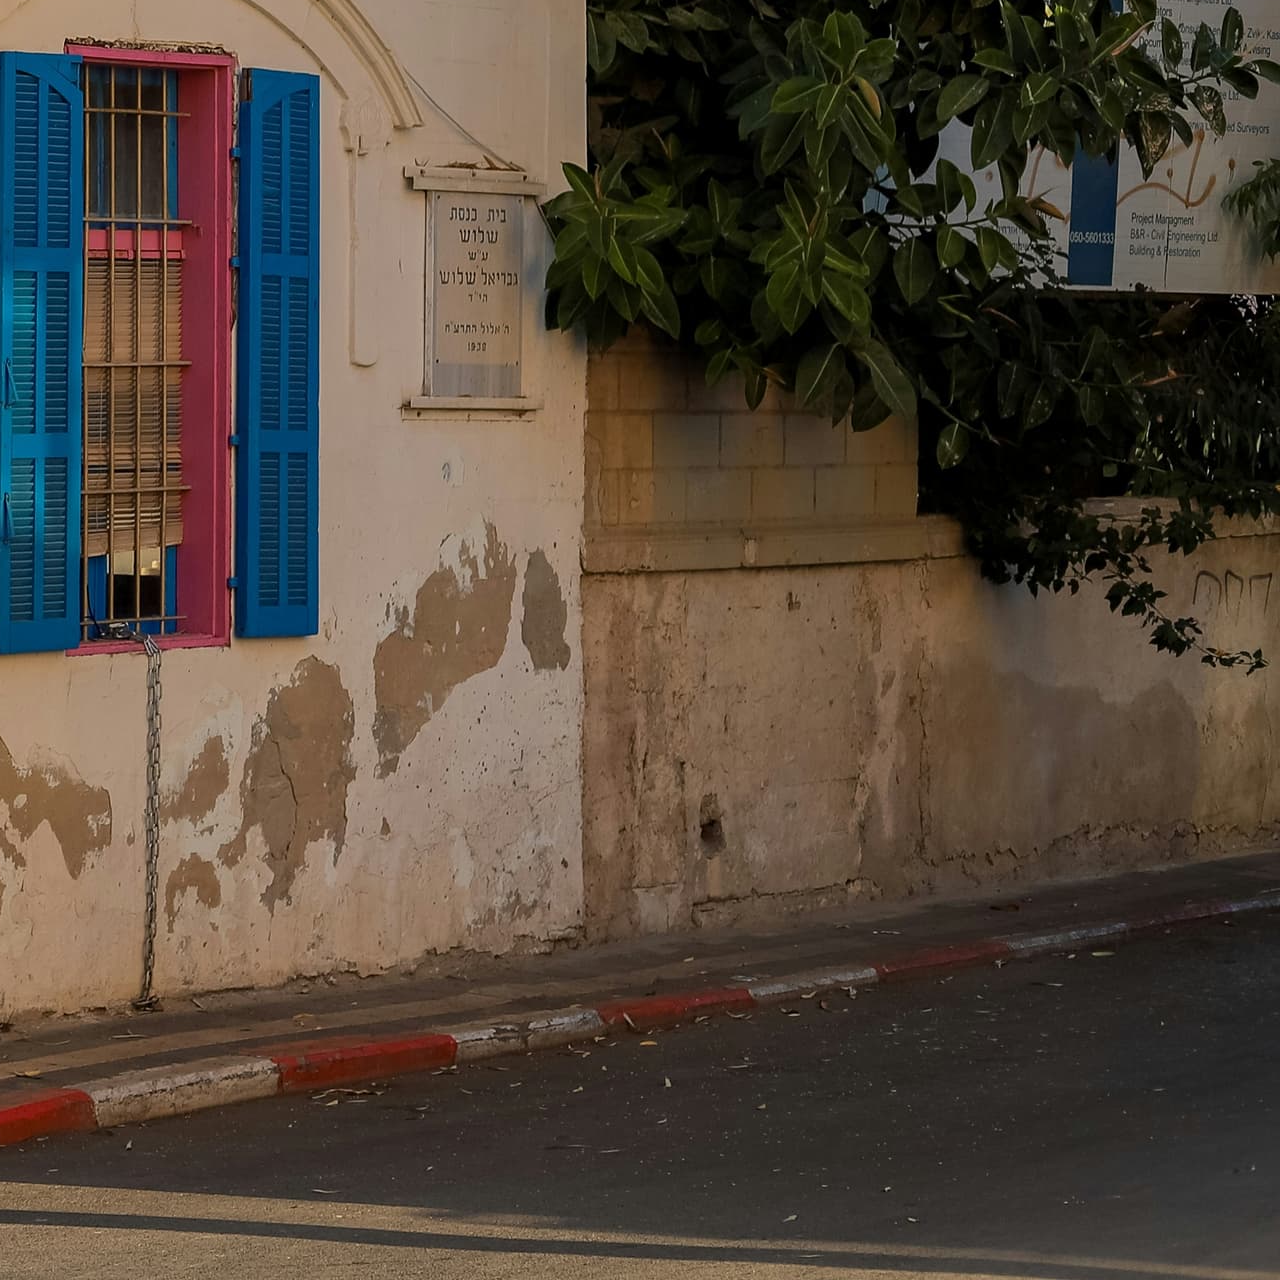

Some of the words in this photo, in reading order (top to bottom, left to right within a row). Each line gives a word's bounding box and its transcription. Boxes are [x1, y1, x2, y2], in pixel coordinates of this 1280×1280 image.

[449, 206, 477, 222] כנסת
[487, 208, 506, 223] בית
[1131, 212, 1154, 226] Project
[459, 226, 498, 244] שלוש
[440, 267, 476, 285] שלוש
[481, 268, 518, 286] גבריאל
